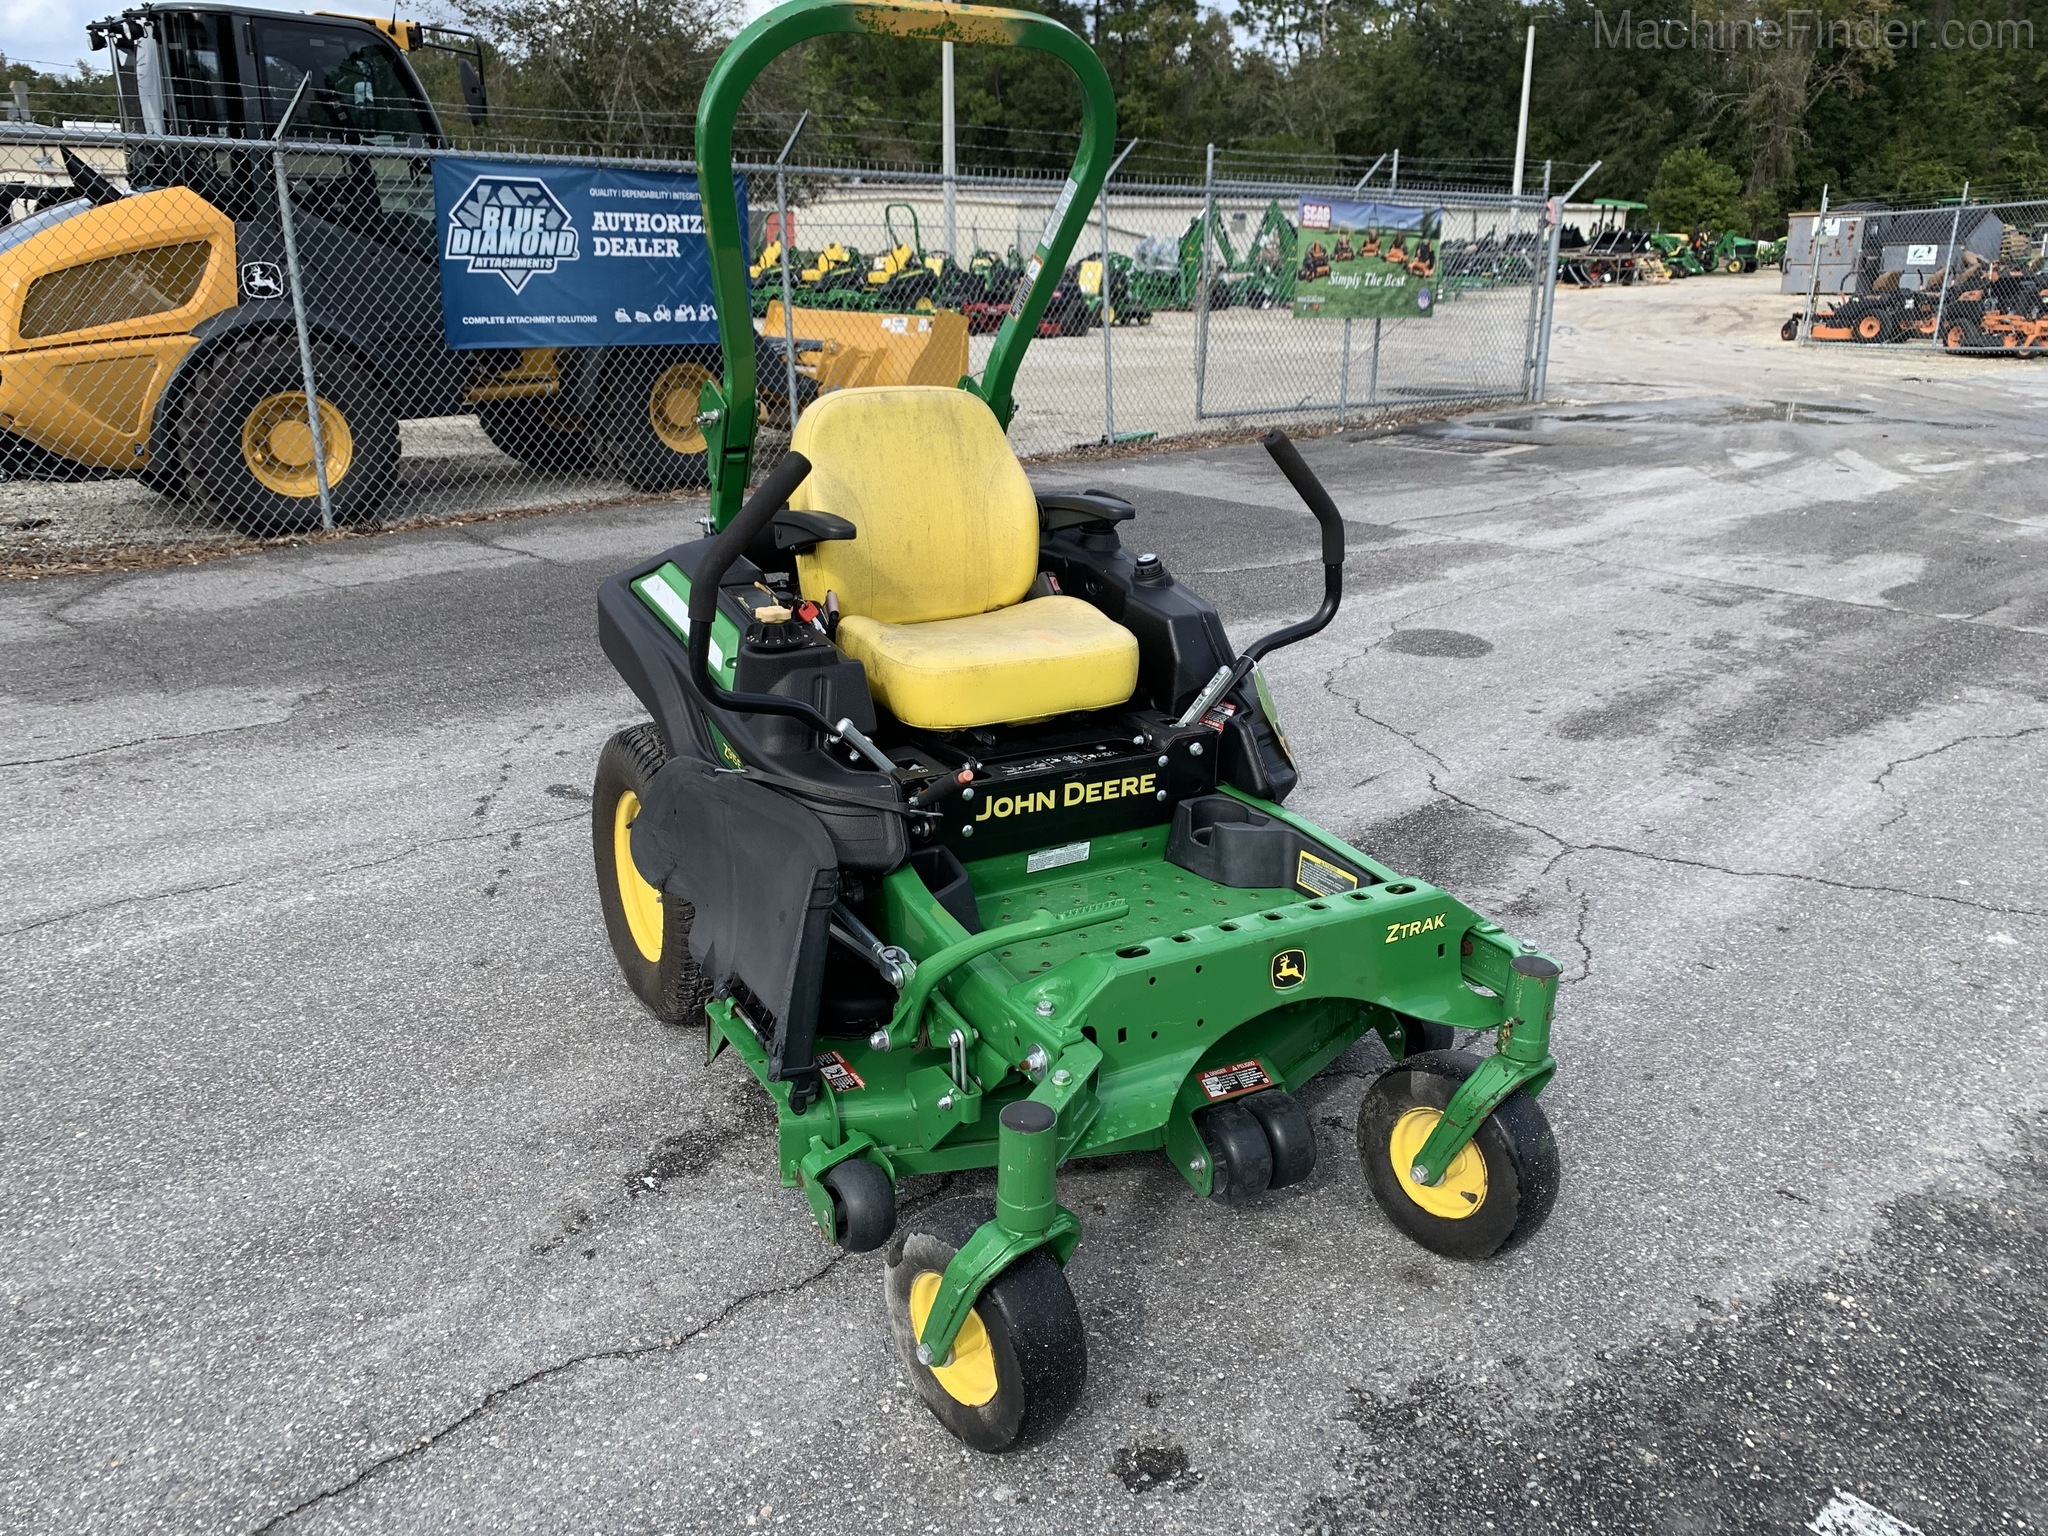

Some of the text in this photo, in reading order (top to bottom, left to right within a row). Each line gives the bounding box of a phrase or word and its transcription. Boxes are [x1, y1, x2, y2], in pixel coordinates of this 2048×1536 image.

[589, 188, 617, 198] QUALITY
[621, 189, 668, 200] DEPENDABILITY
[481, 206, 546, 231] BLUE
[451, 228, 574, 256] DIAMOND
[593, 237, 680, 257] DEALER
[474, 257, 553, 269] ATTACHMENTS
[1328, 272, 1361, 290] Simply
[1364, 272, 1383, 287] The
[462, 315, 598, 325] COMPLETE ATTACHMENT SOLUTIONS
[975, 773, 1157, 822] JOHN DEERE
[1385, 912, 1447, 944] ZTRAK
